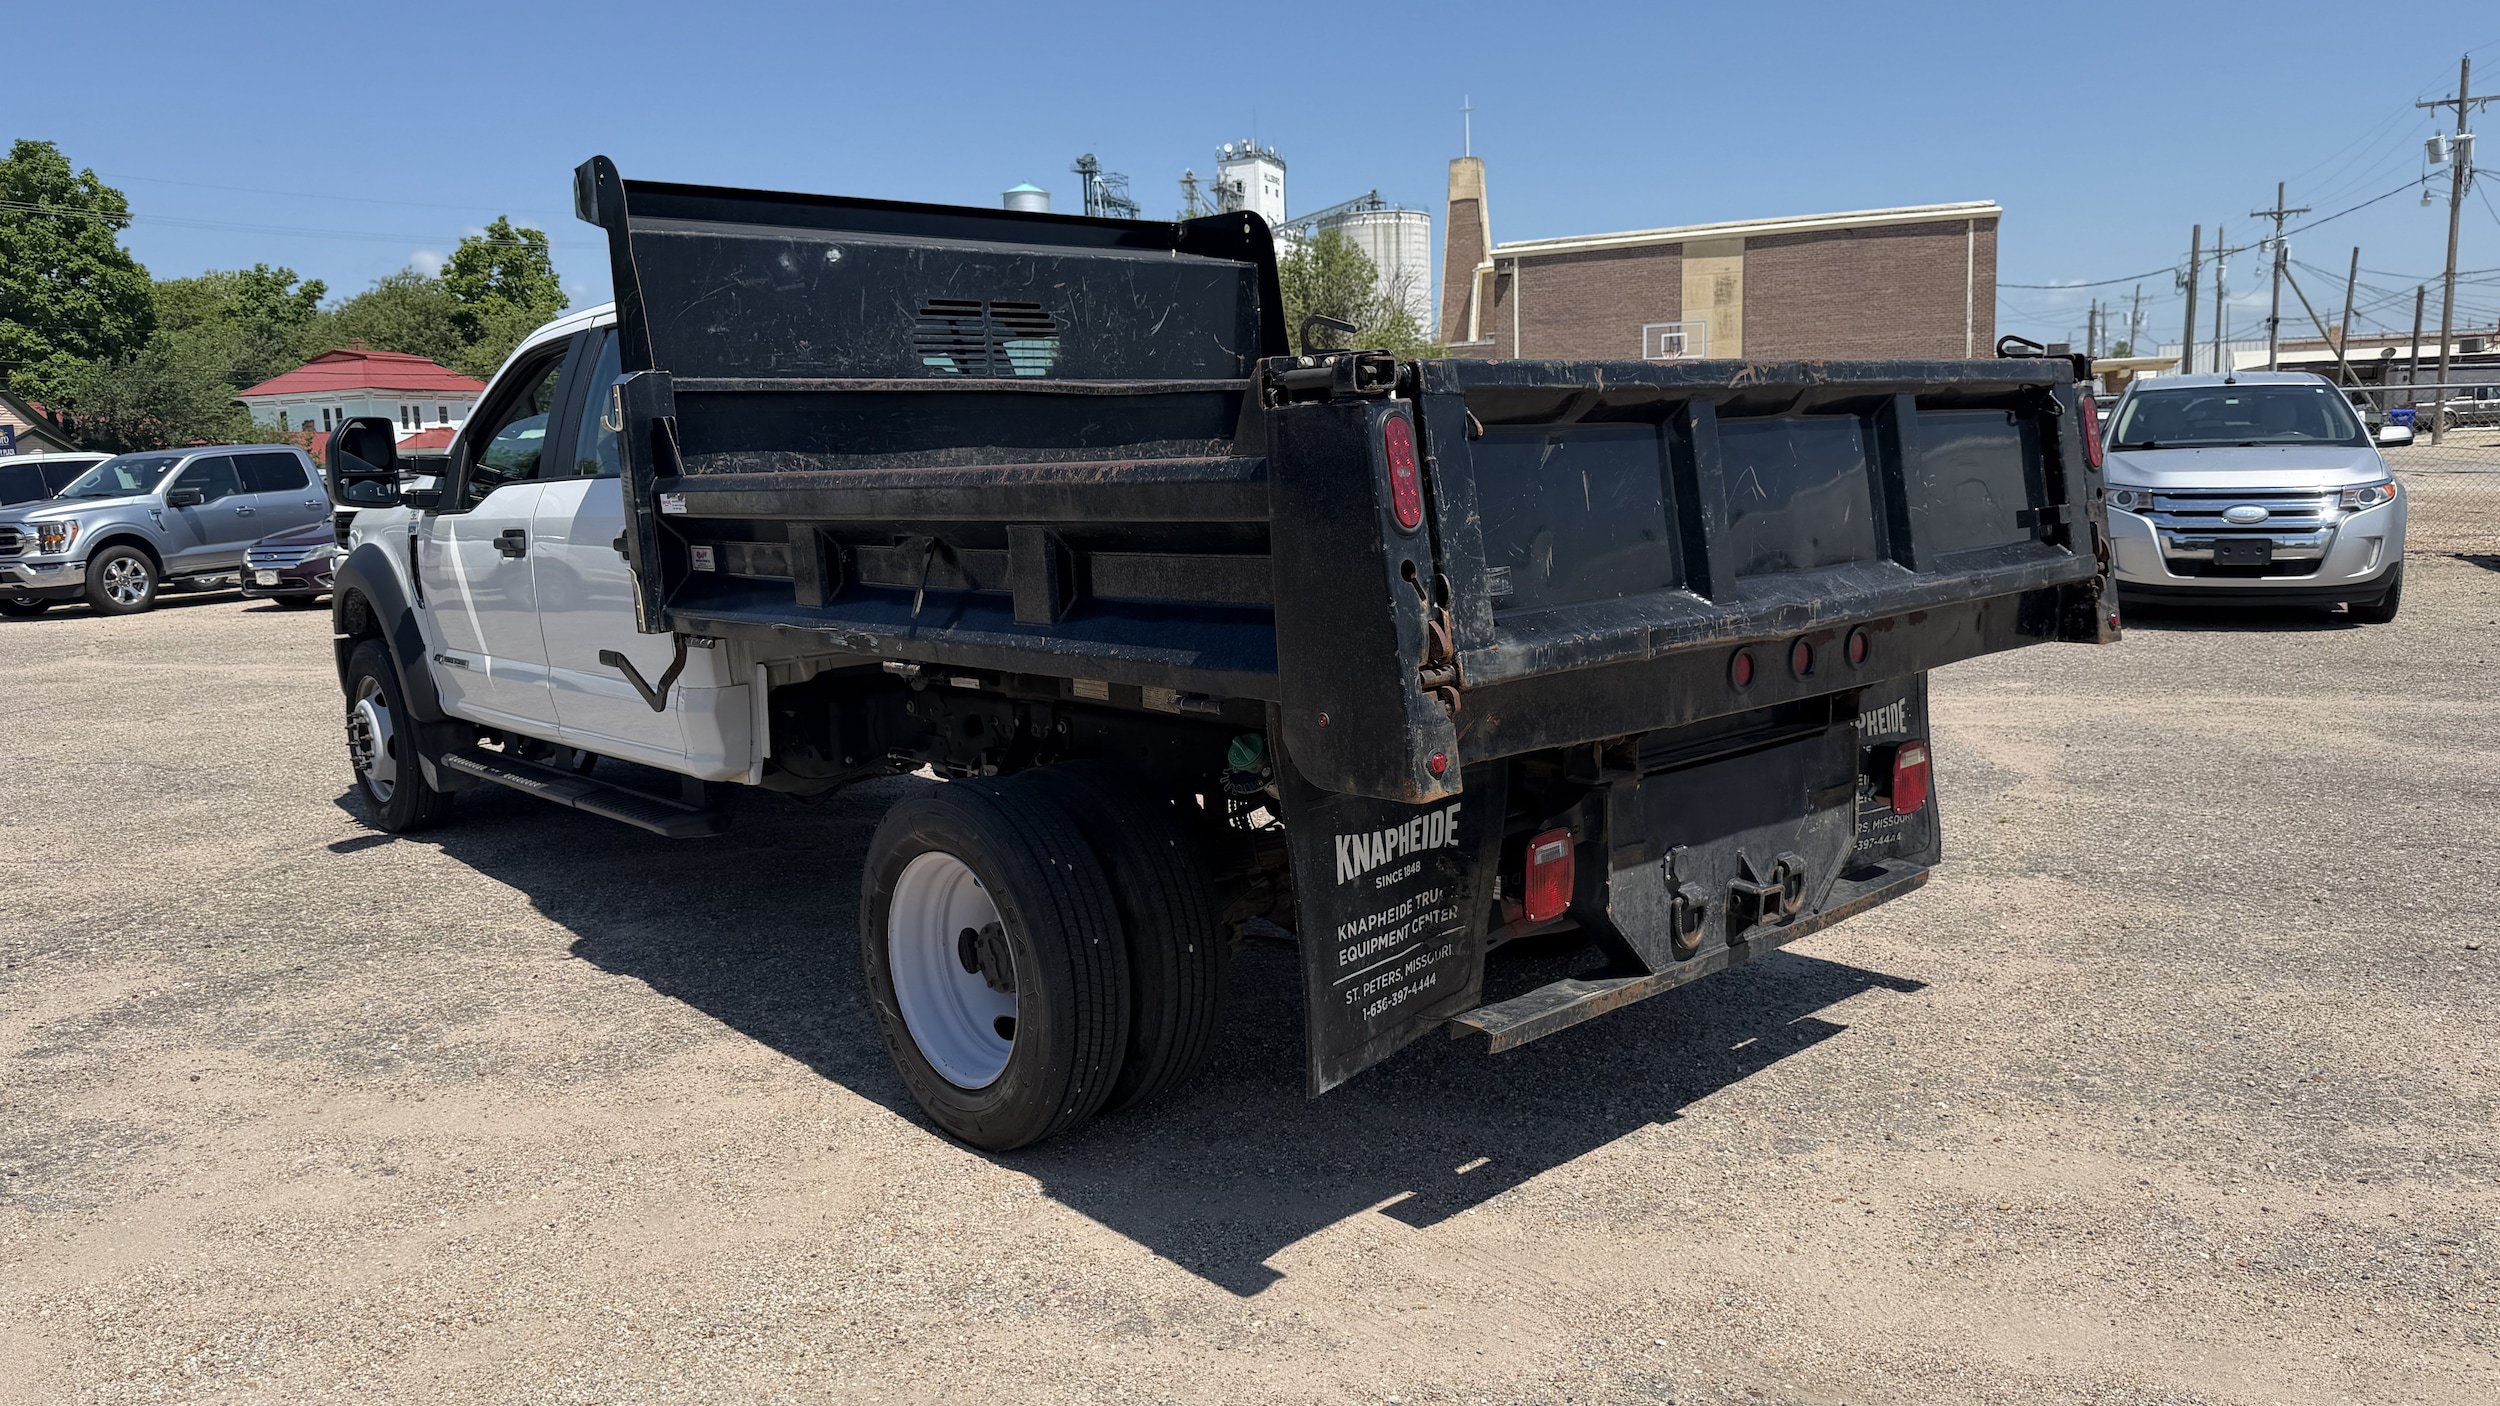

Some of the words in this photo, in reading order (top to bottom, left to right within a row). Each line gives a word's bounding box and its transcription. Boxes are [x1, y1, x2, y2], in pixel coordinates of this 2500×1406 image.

[1335, 802, 1461, 886] KNAPHEIDE
[1375, 868, 1404, 889] SINCE
[1403, 860, 1421, 876] 1848
[1337, 898, 1413, 942] KNAPHEIDE
[1339, 922, 1411, 967] EQUIPMENT
[1345, 986, 1361, 1005] ST.
[1363, 967, 1404, 997] PETERS,
[1405, 943, 1453, 976] MISSOURI
[1362, 972, 1437, 1021] 1-636-397-4444
